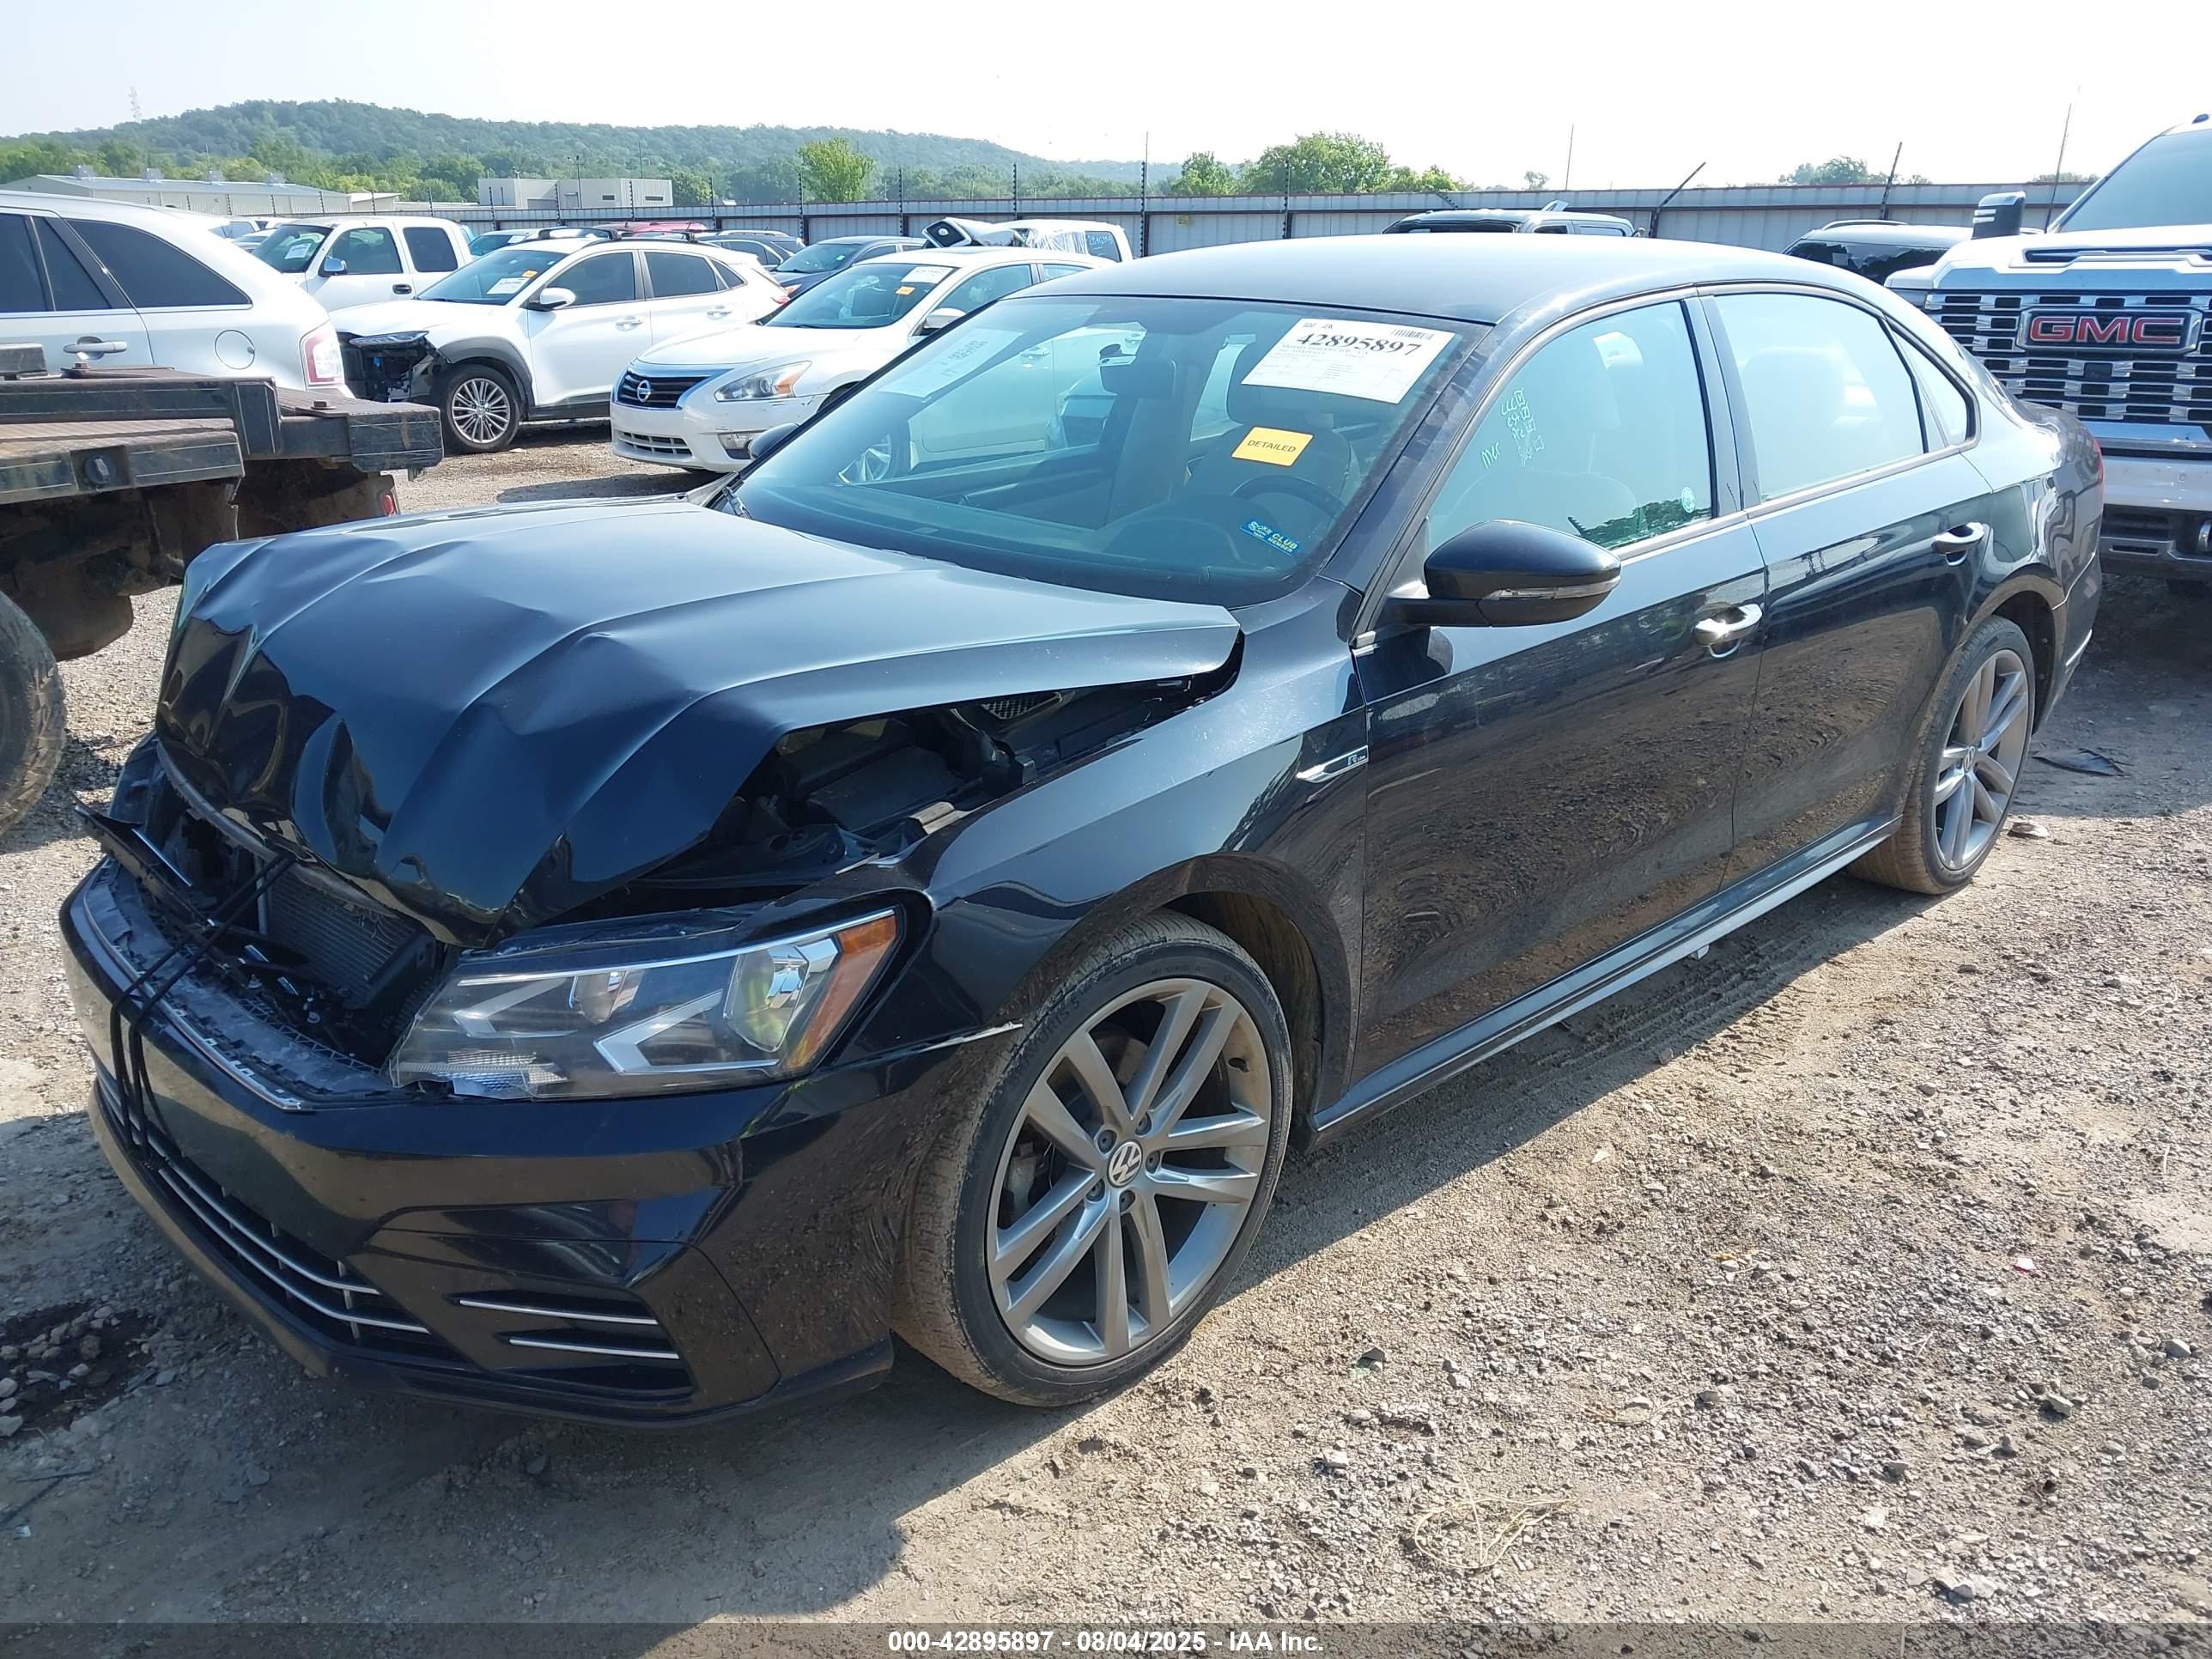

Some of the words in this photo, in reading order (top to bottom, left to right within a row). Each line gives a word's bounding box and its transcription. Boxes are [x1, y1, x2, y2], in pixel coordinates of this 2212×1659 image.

[2029, 315, 2185, 344] GMC
[1296, 332, 1423, 356] 42895897
[1247, 439, 1297, 453] DETAILED
[1267, 538, 1293, 553] MEMBER
[1272, 533, 1297, 550] CLUB
